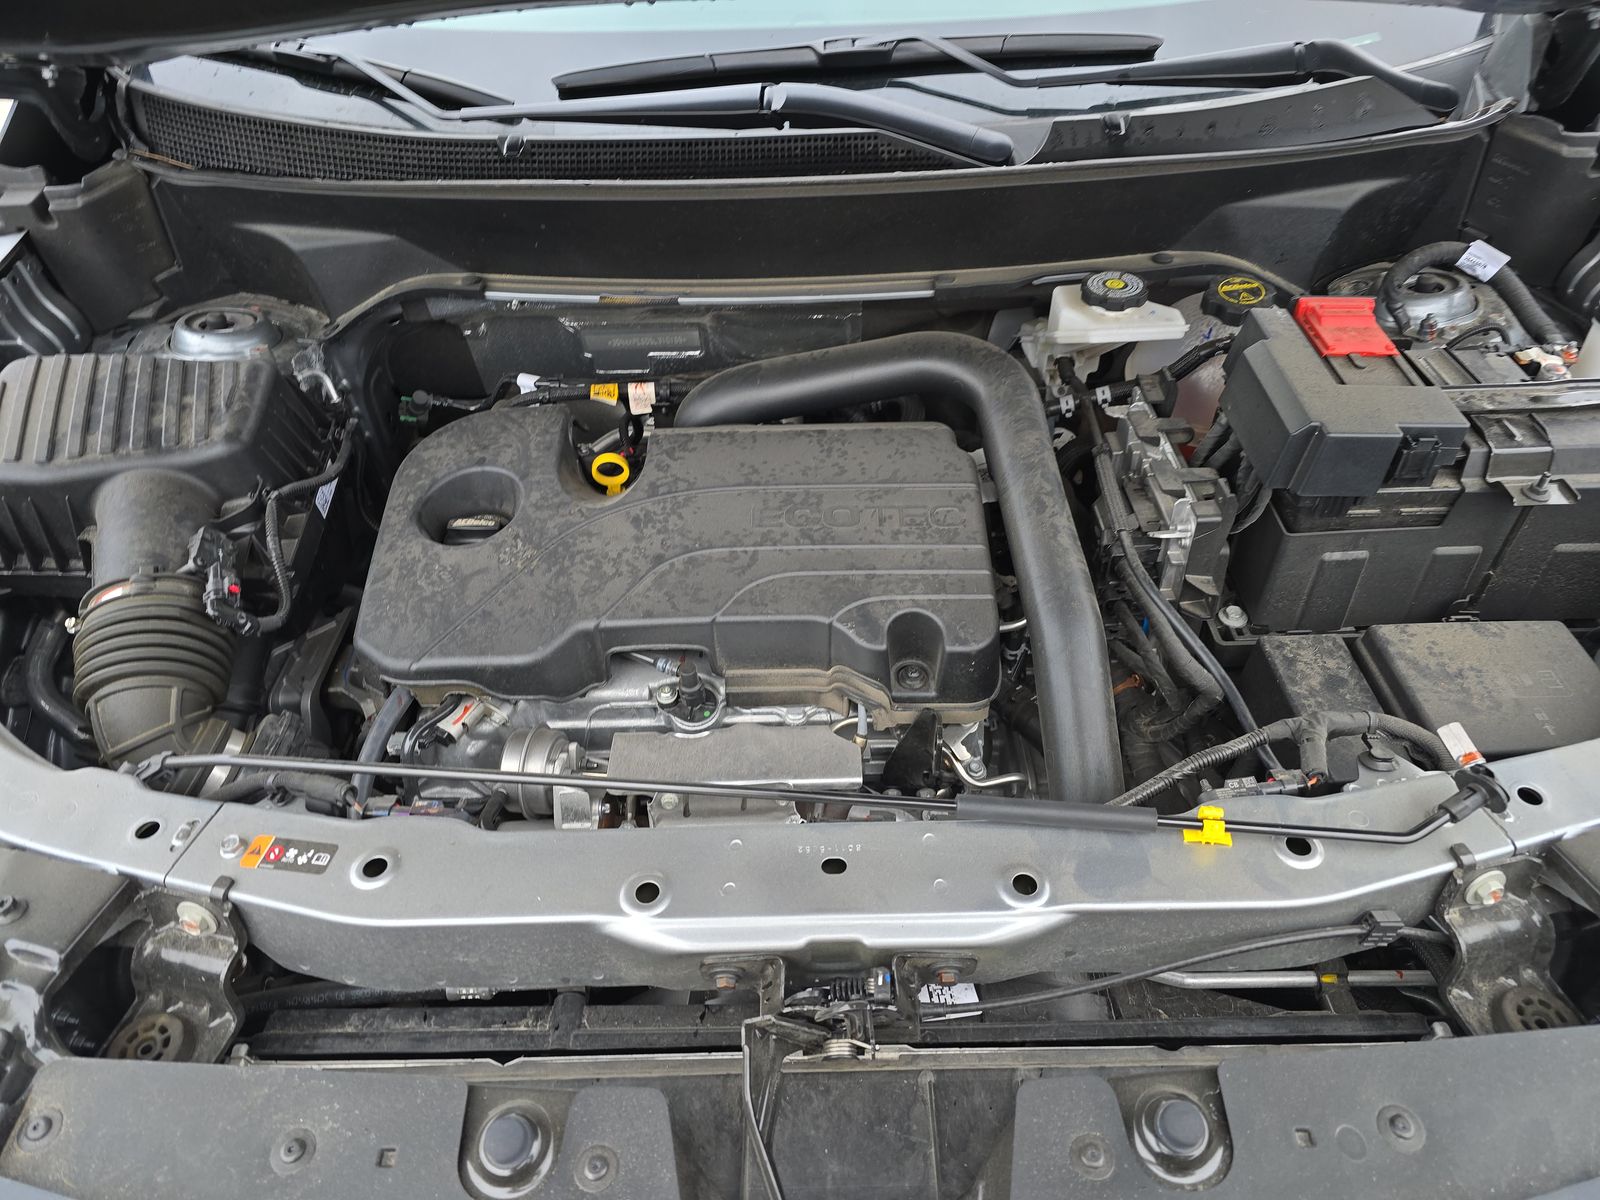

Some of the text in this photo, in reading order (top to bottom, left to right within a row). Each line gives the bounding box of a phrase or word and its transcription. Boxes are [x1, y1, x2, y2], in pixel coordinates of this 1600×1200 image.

[751, 504, 967, 529] ECOTEC
[452, 518, 496, 527] ACDelco
[1228, 781, 1240, 789] CB
